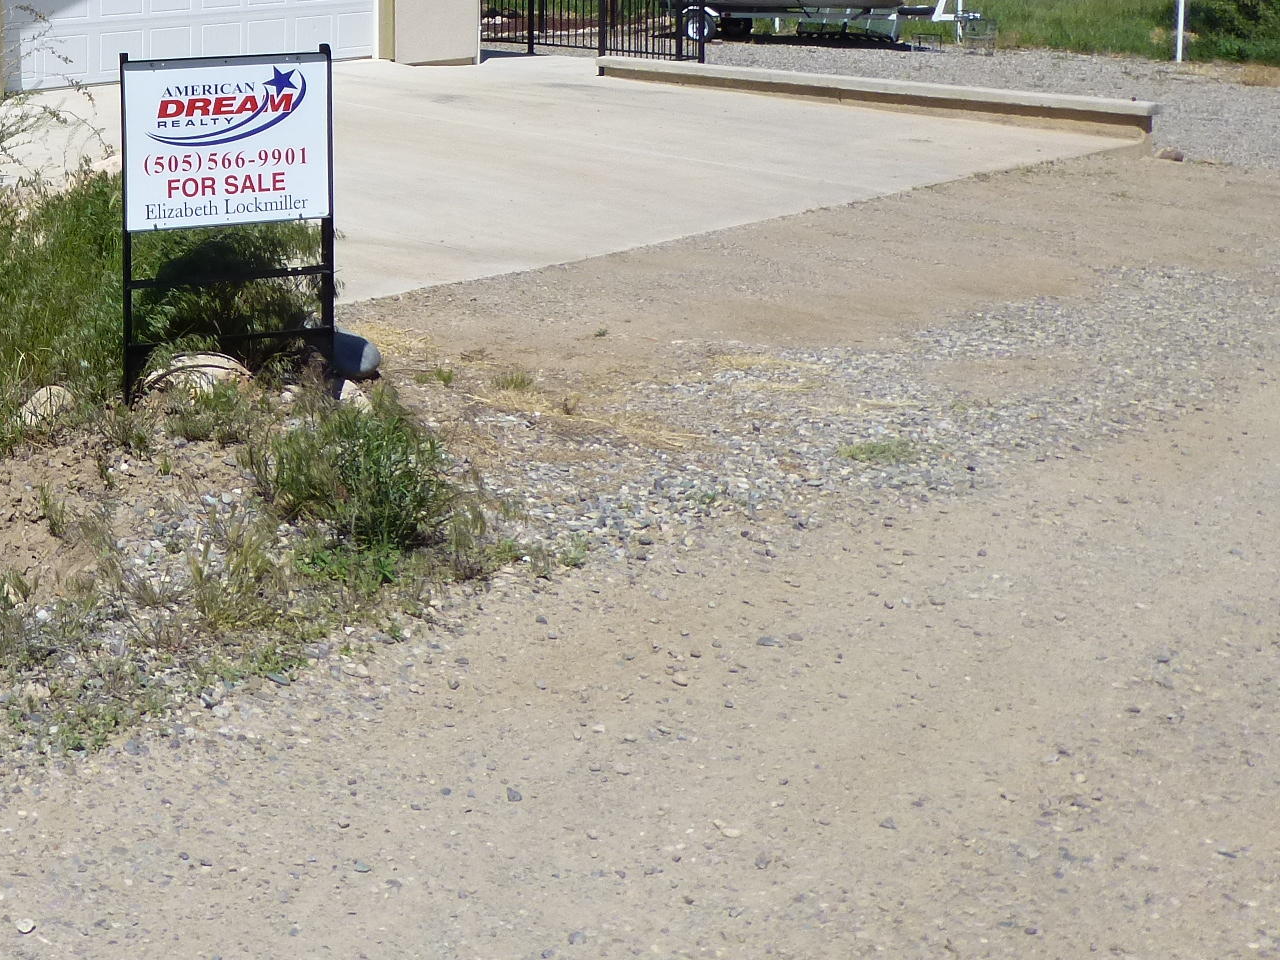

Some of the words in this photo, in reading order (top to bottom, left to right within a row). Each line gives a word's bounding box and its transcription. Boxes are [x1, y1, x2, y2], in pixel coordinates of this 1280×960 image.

[162, 82, 255, 98] AMERICAN
[157, 93, 293, 119] DREAM
[157, 117, 234, 129] REALTY
[167, 176, 216, 198] FOR
[224, 172, 286, 194] SALE
[145, 200, 219, 220] Elizabeth
[224, 194, 308, 215] Lockmiller
